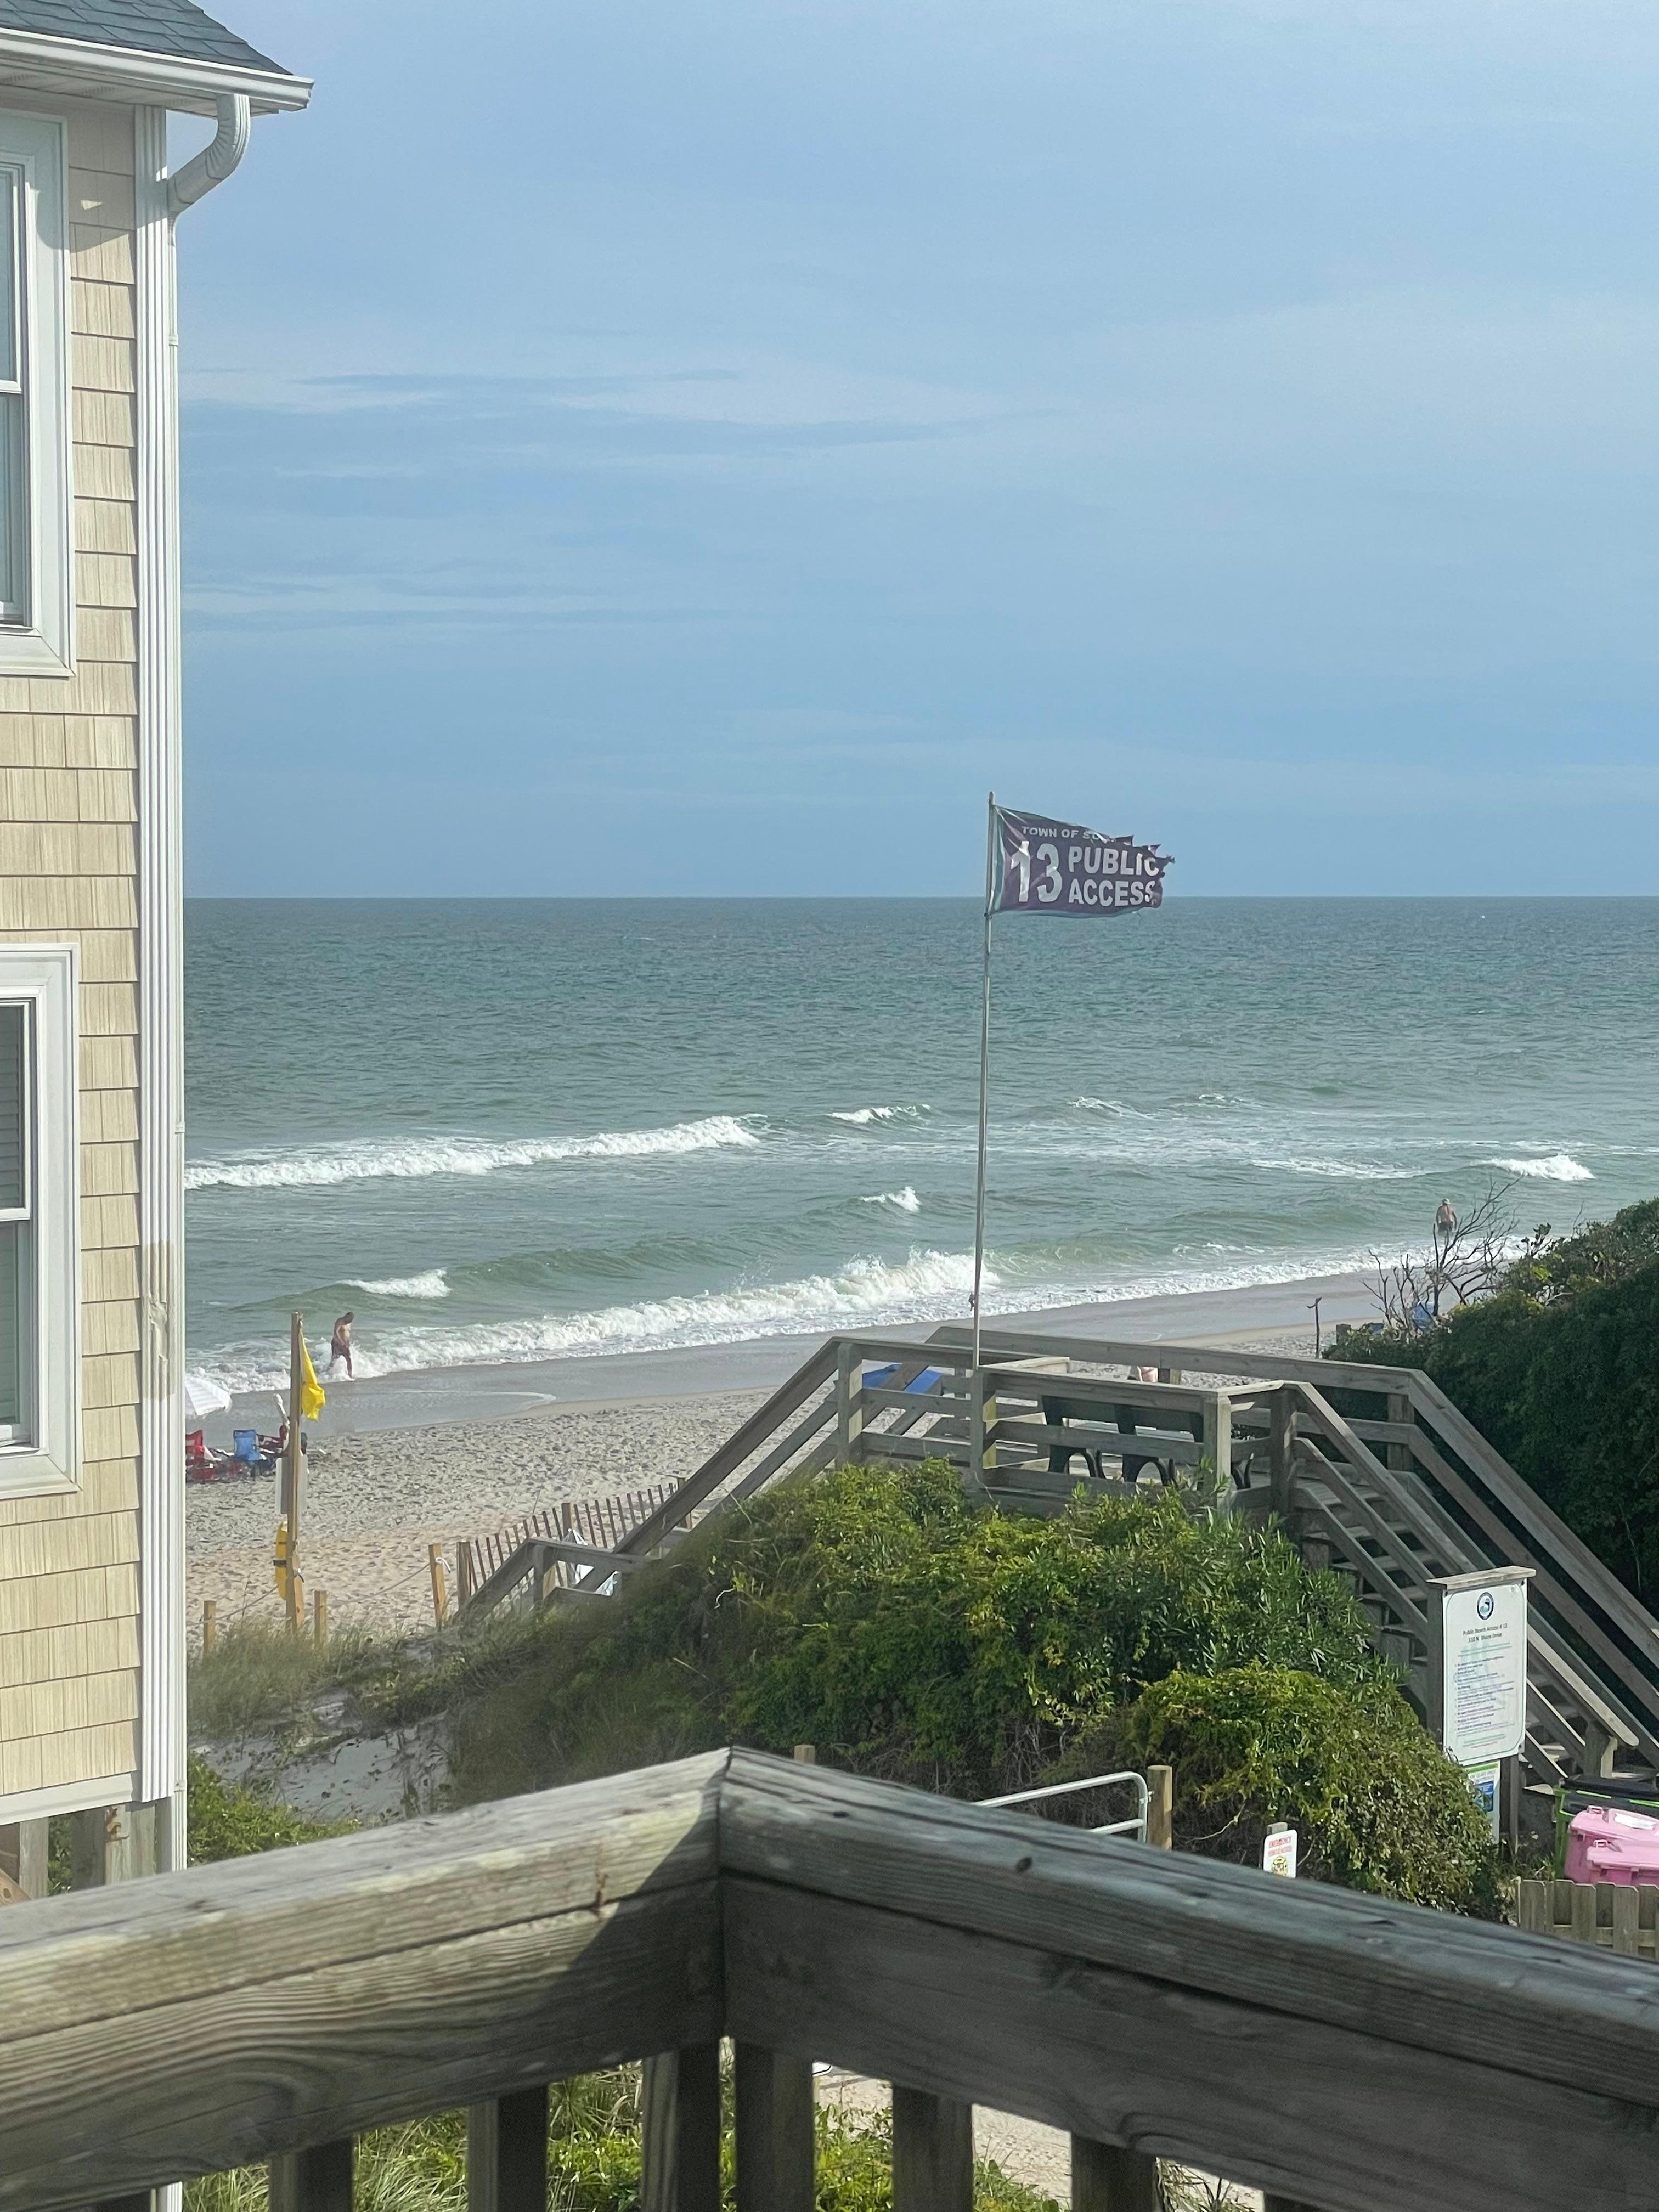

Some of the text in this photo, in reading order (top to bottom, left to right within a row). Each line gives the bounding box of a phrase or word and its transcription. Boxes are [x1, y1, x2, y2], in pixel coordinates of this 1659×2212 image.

[1022, 826, 1057, 838] TOWN
[1061, 829, 1079, 839] OF
[1011, 840, 1063, 902] 13
[1069, 845, 1159, 877] PUBLIC
[1068, 878, 1156, 907] ACCESS
